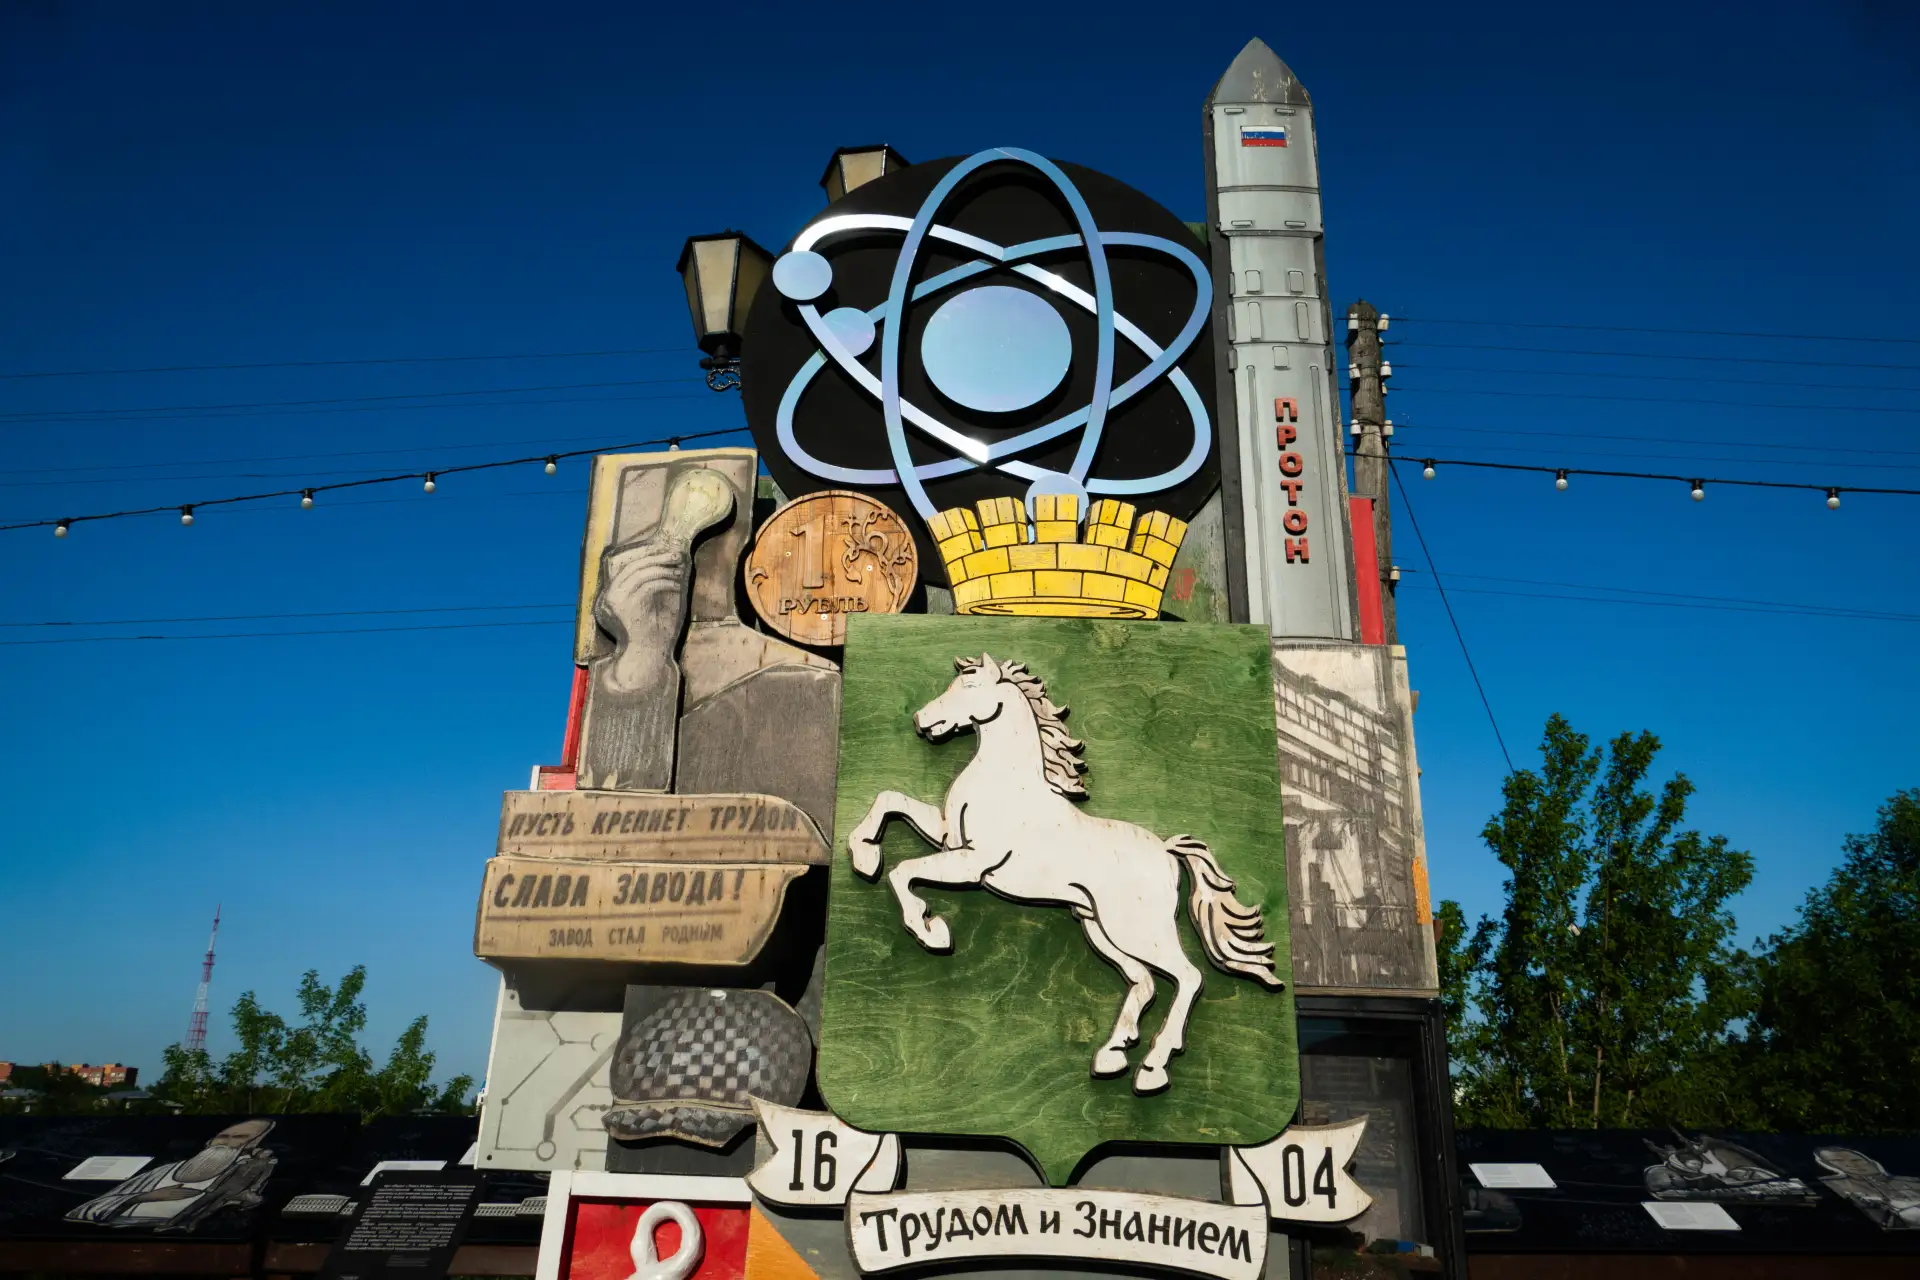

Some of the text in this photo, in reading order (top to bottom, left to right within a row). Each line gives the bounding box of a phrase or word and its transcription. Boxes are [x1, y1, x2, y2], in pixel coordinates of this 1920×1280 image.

[1275, 397, 1309, 564] ПРОТОН
[789, 514, 825, 589] 1
[778, 597, 869, 615] РУБЛЬ
[508, 804, 800, 837] ПУСТЬ КРЕПНЕТ ТРУДОМ
[494, 869, 745, 908] СЛАВА ЗАВОДА!
[549, 922, 723, 947] ЗАВОД СТАЛ РОДНЫМ
[789, 1129, 838, 1192] 16
[1282, 1144, 1338, 1209] 04
[860, 1200, 1253, 1263] Трудом и Знанием
